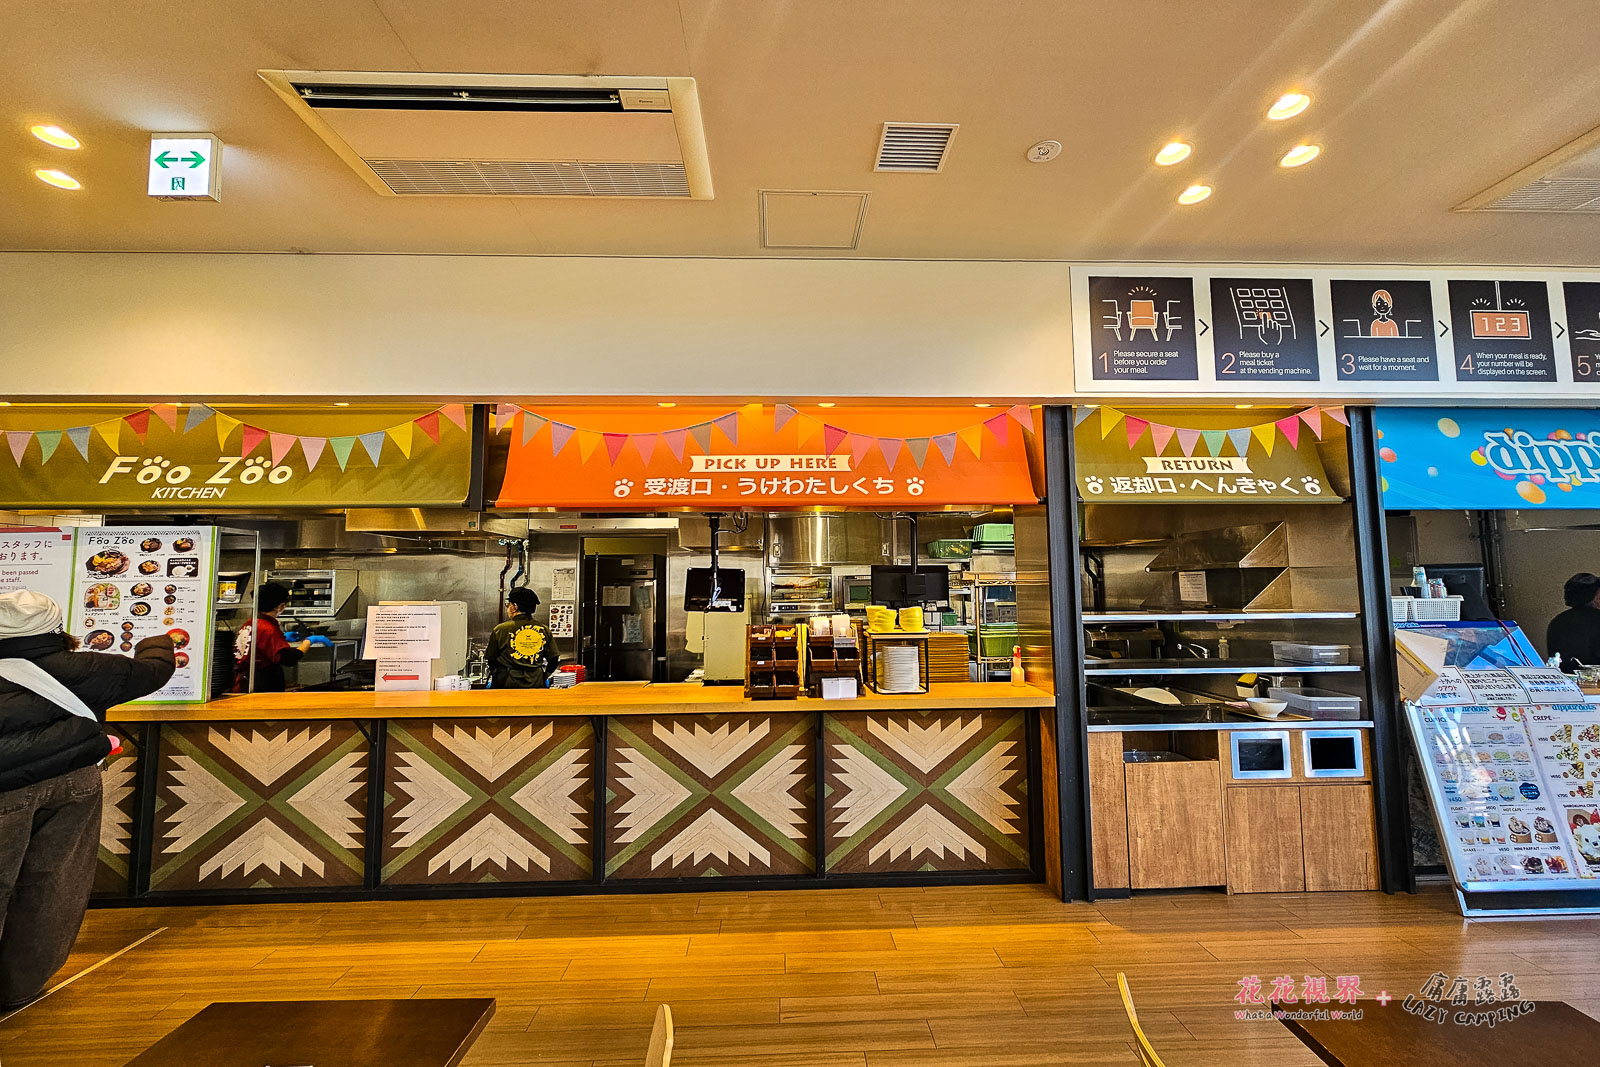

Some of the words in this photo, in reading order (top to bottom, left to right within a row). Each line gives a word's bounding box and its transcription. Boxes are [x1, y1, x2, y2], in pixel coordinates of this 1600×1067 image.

[1261, 351, 1275, 359] buy
[1358, 355, 1379, 363] Please
[1380, 355, 1396, 363] have
[1099, 351, 1108, 373] 1
[1135, 359, 1149, 367] you
[1221, 352, 1236, 374] 2
[1341, 353, 1356, 375] 3
[1460, 354, 1475, 375] 4
[1577, 355, 1591, 376] 5
[1257, 367, 1283, 375] vending
[1284, 367, 1312, 375] machine.
[1477, 368, 1506, 376] displayed
[704, 458, 746, 470] PICK
[755, 458, 781, 470] UP
[790, 458, 837, 470] HERE
[1161, 459, 1234, 471] RETURN
[643, 477, 895, 496] 受渡口・うけわたしくち
[151, 487, 227, 499] KITCHEN
[18, 569, 39, 578] passed
